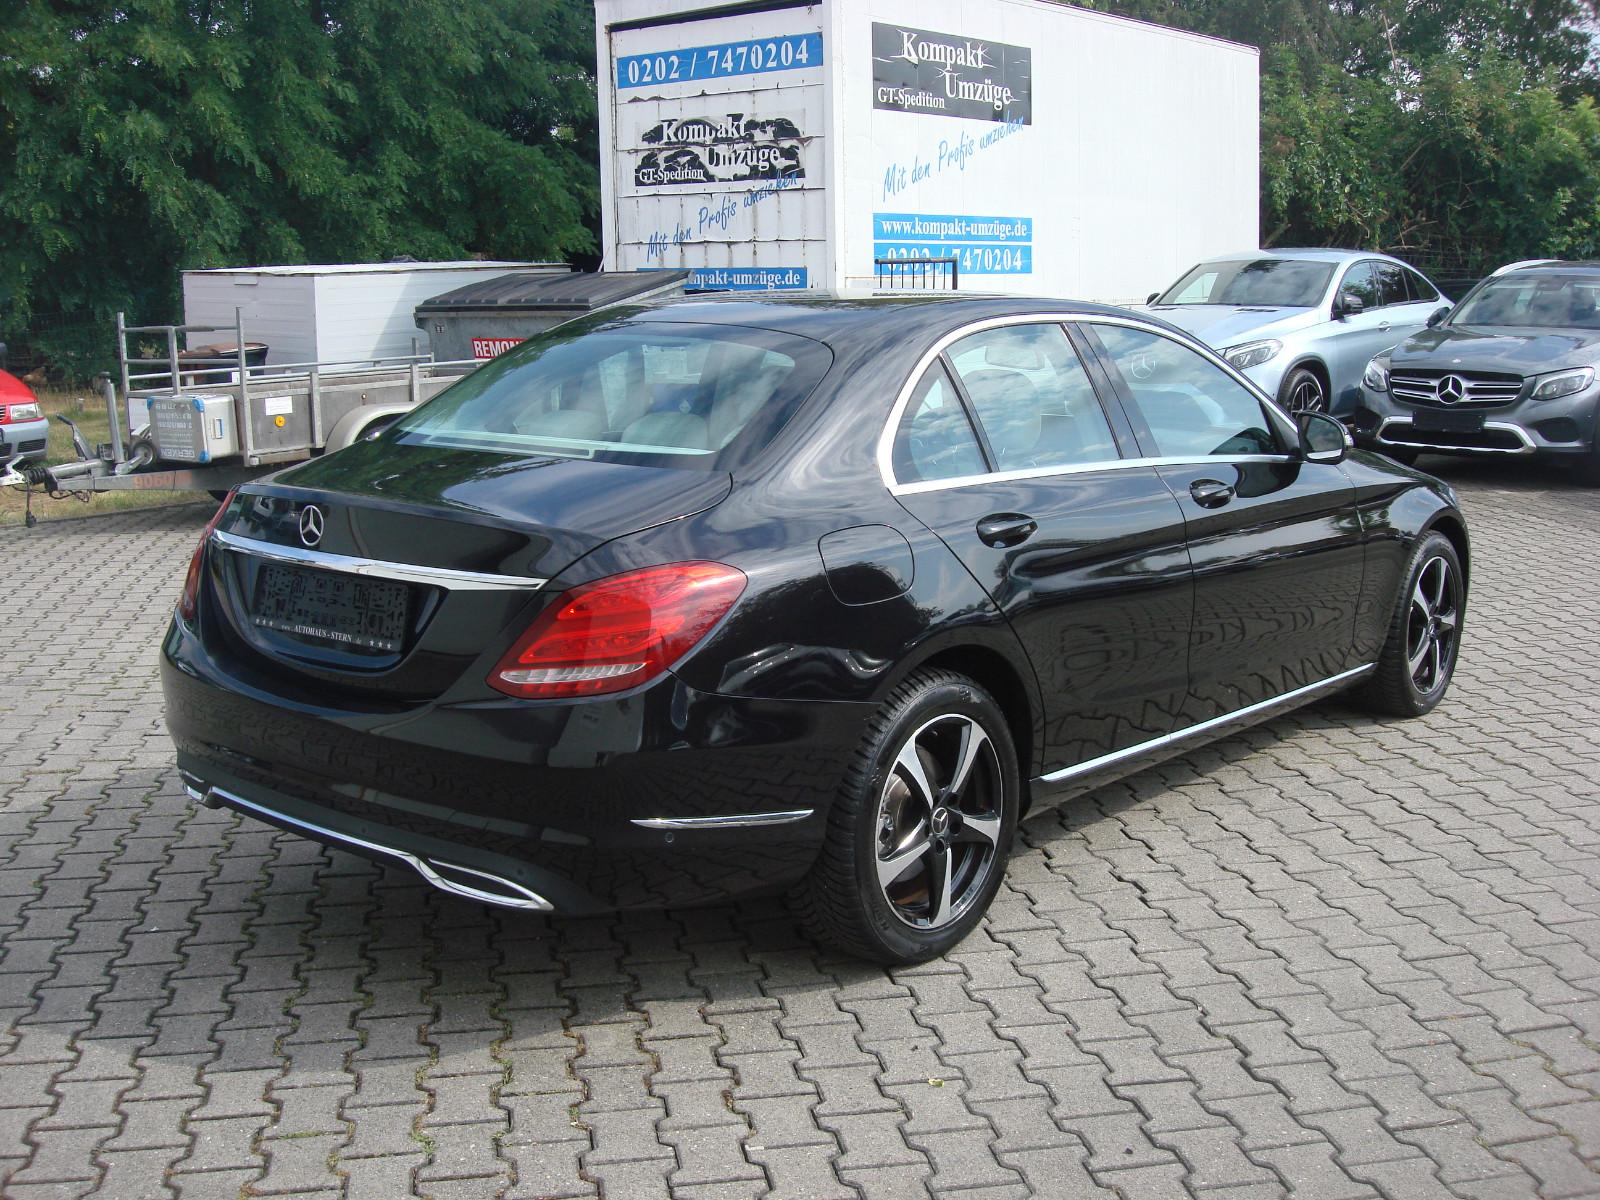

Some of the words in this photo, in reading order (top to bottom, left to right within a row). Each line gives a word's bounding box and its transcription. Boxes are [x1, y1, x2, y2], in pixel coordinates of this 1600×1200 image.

[628, 55, 680, 83] 0202
[690, 52, 697, 77] /
[707, 38, 809, 75] 7470204
[898, 30, 985, 70] Kompakt
[877, 86, 945, 109] GT-Spedition
[944, 70, 1013, 110] Umzüge
[639, 167, 705, 184] GT-Spedition
[883, 163, 907, 203] Mit
[911, 154, 931, 184] den
[937, 130, 975, 172] Profis
[979, 109, 1025, 150] umziehen
[647, 229, 668, 263] Mit
[672, 222, 692, 246] den
[698, 195, 738, 234] Profis
[881, 216, 1028, 240] www.kompakt-umzüge.de
[887, 247, 931, 271] 0202
